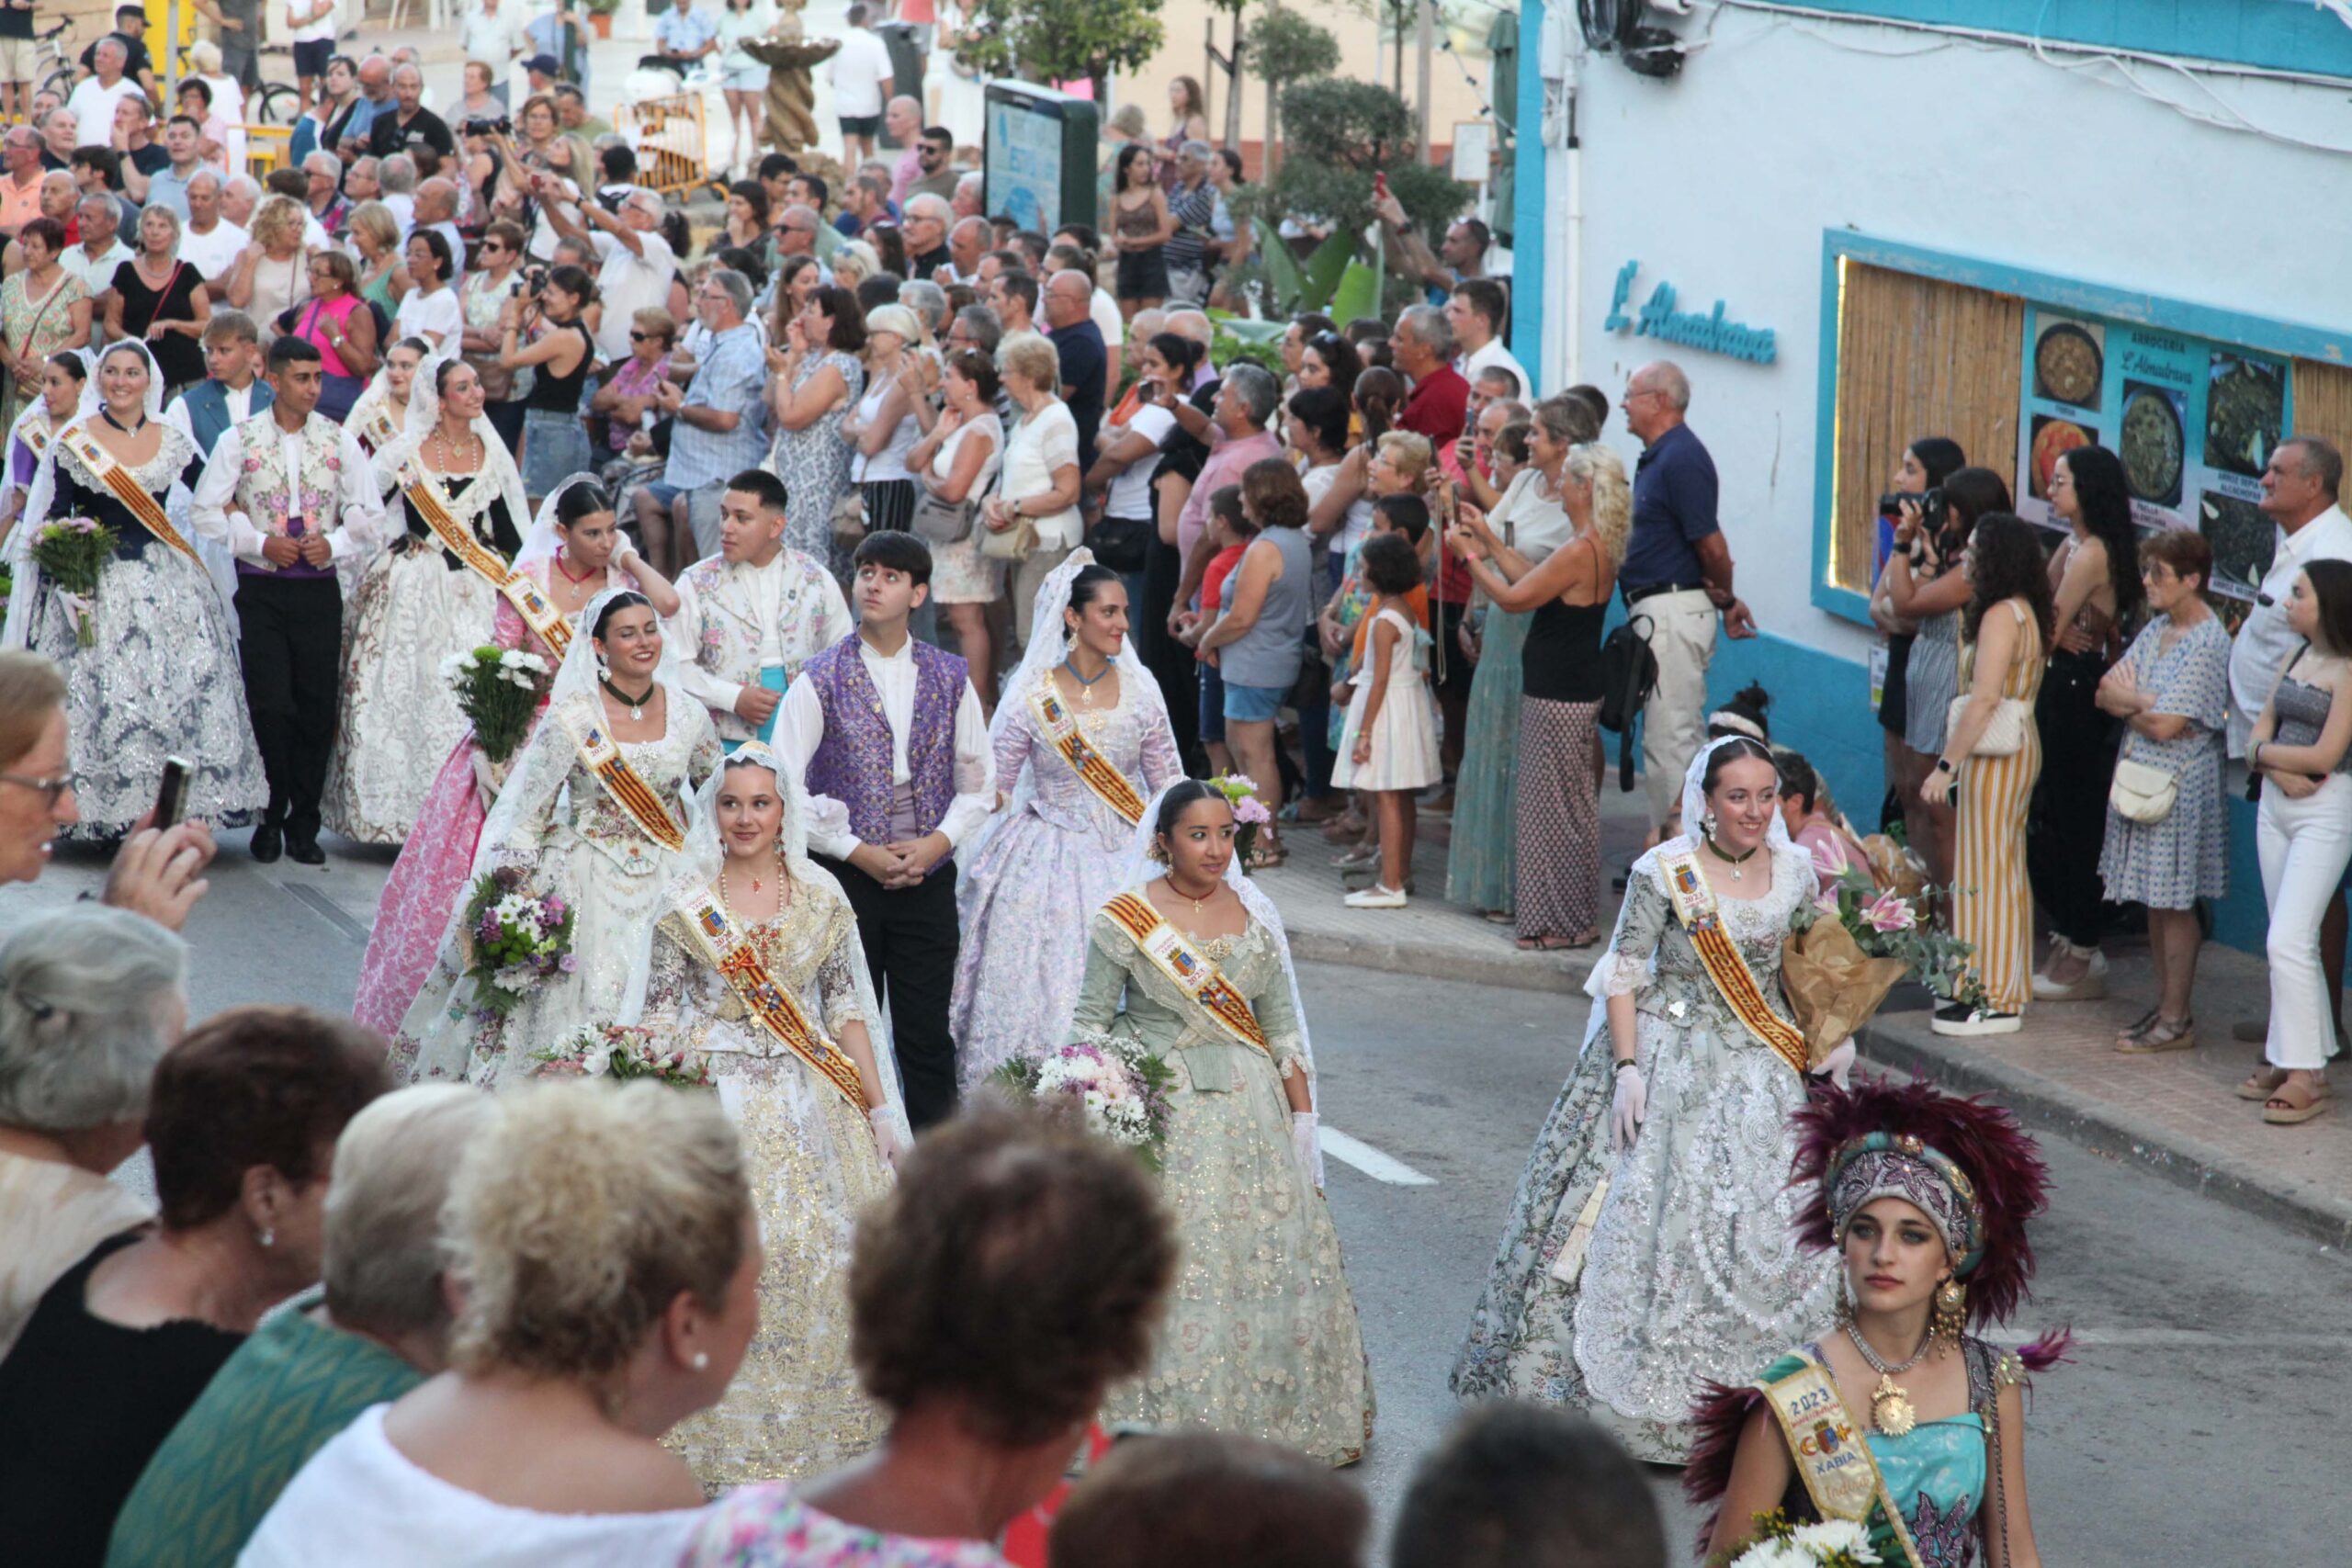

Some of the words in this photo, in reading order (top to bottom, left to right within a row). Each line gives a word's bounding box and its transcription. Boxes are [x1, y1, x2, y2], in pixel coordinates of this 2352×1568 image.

[591, 742, 608, 757] 2023
[1683, 891, 1704, 905] 2023
[1187, 966, 1207, 986] 2023
[1791, 1386, 1830, 1416] 2023
[1815, 1450, 1857, 1475] XABIA
